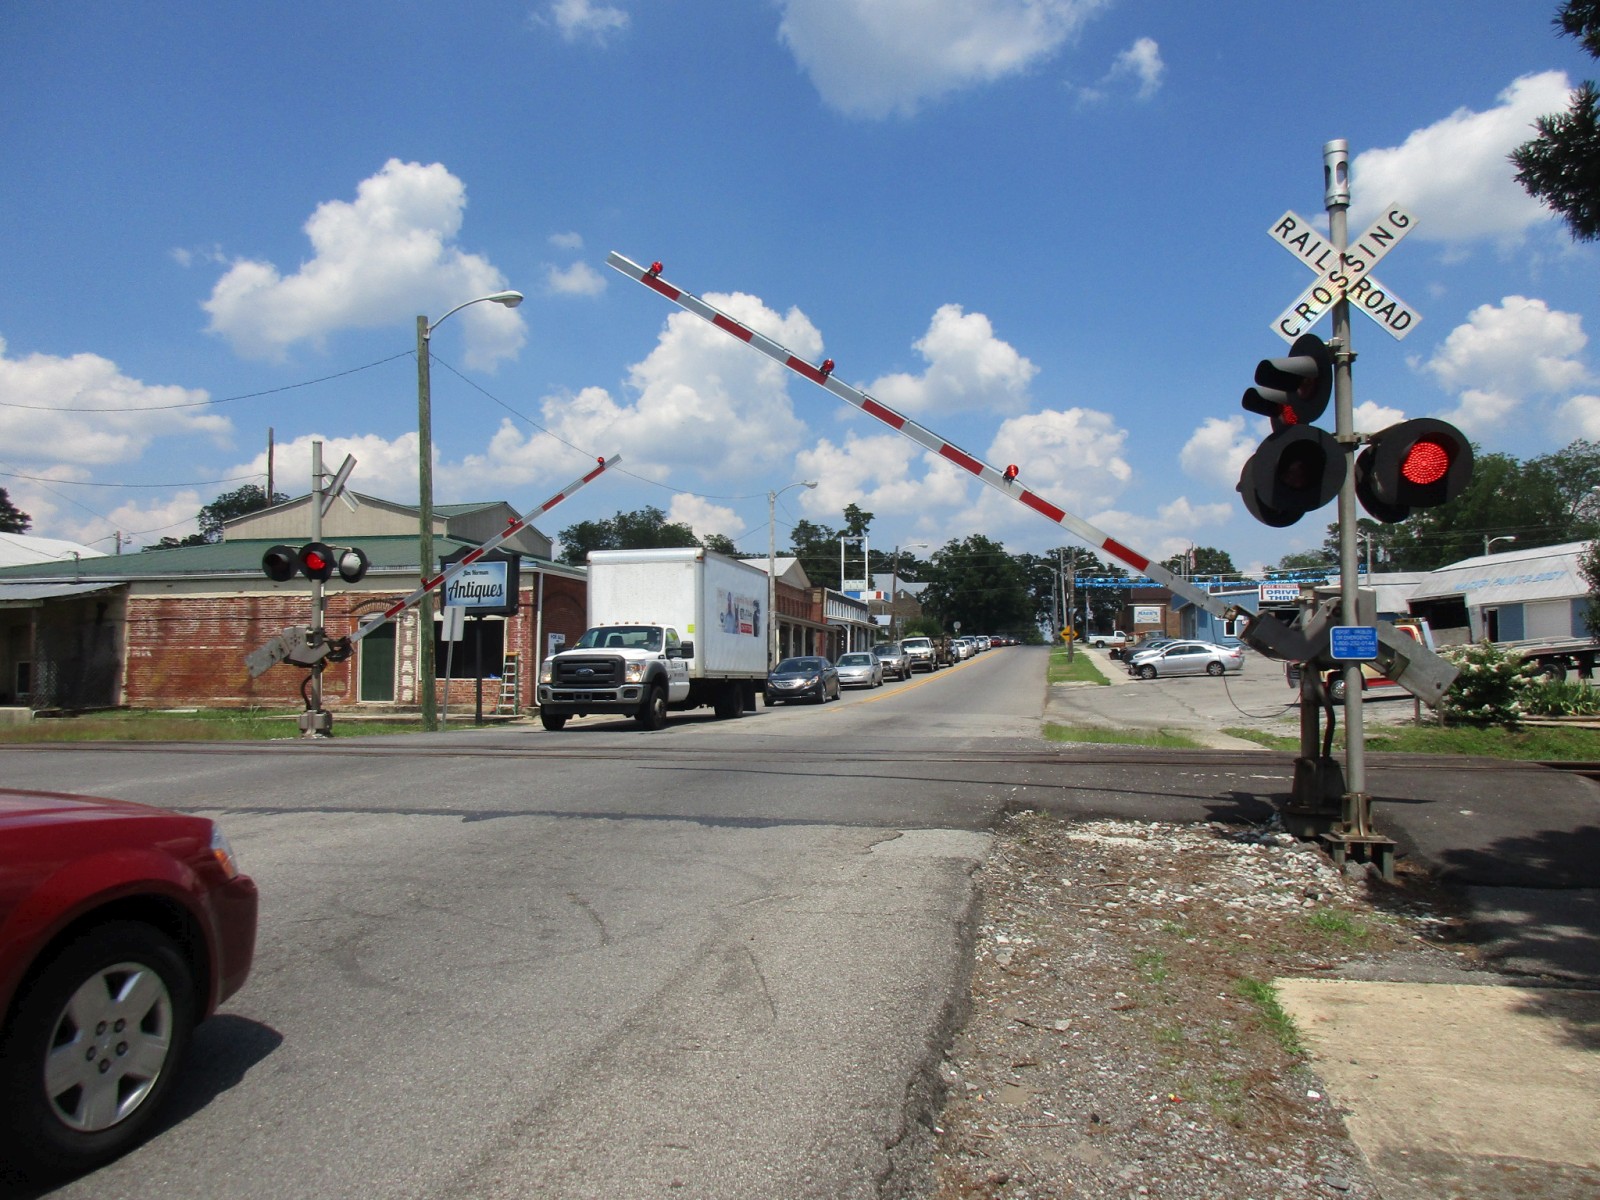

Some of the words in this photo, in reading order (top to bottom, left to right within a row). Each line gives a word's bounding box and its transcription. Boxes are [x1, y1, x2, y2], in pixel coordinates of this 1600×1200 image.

[1274, 217, 1331, 271] RAIL
[1280, 210, 1409, 337] CROSSING
[448, 579, 504, 604] Antiques
